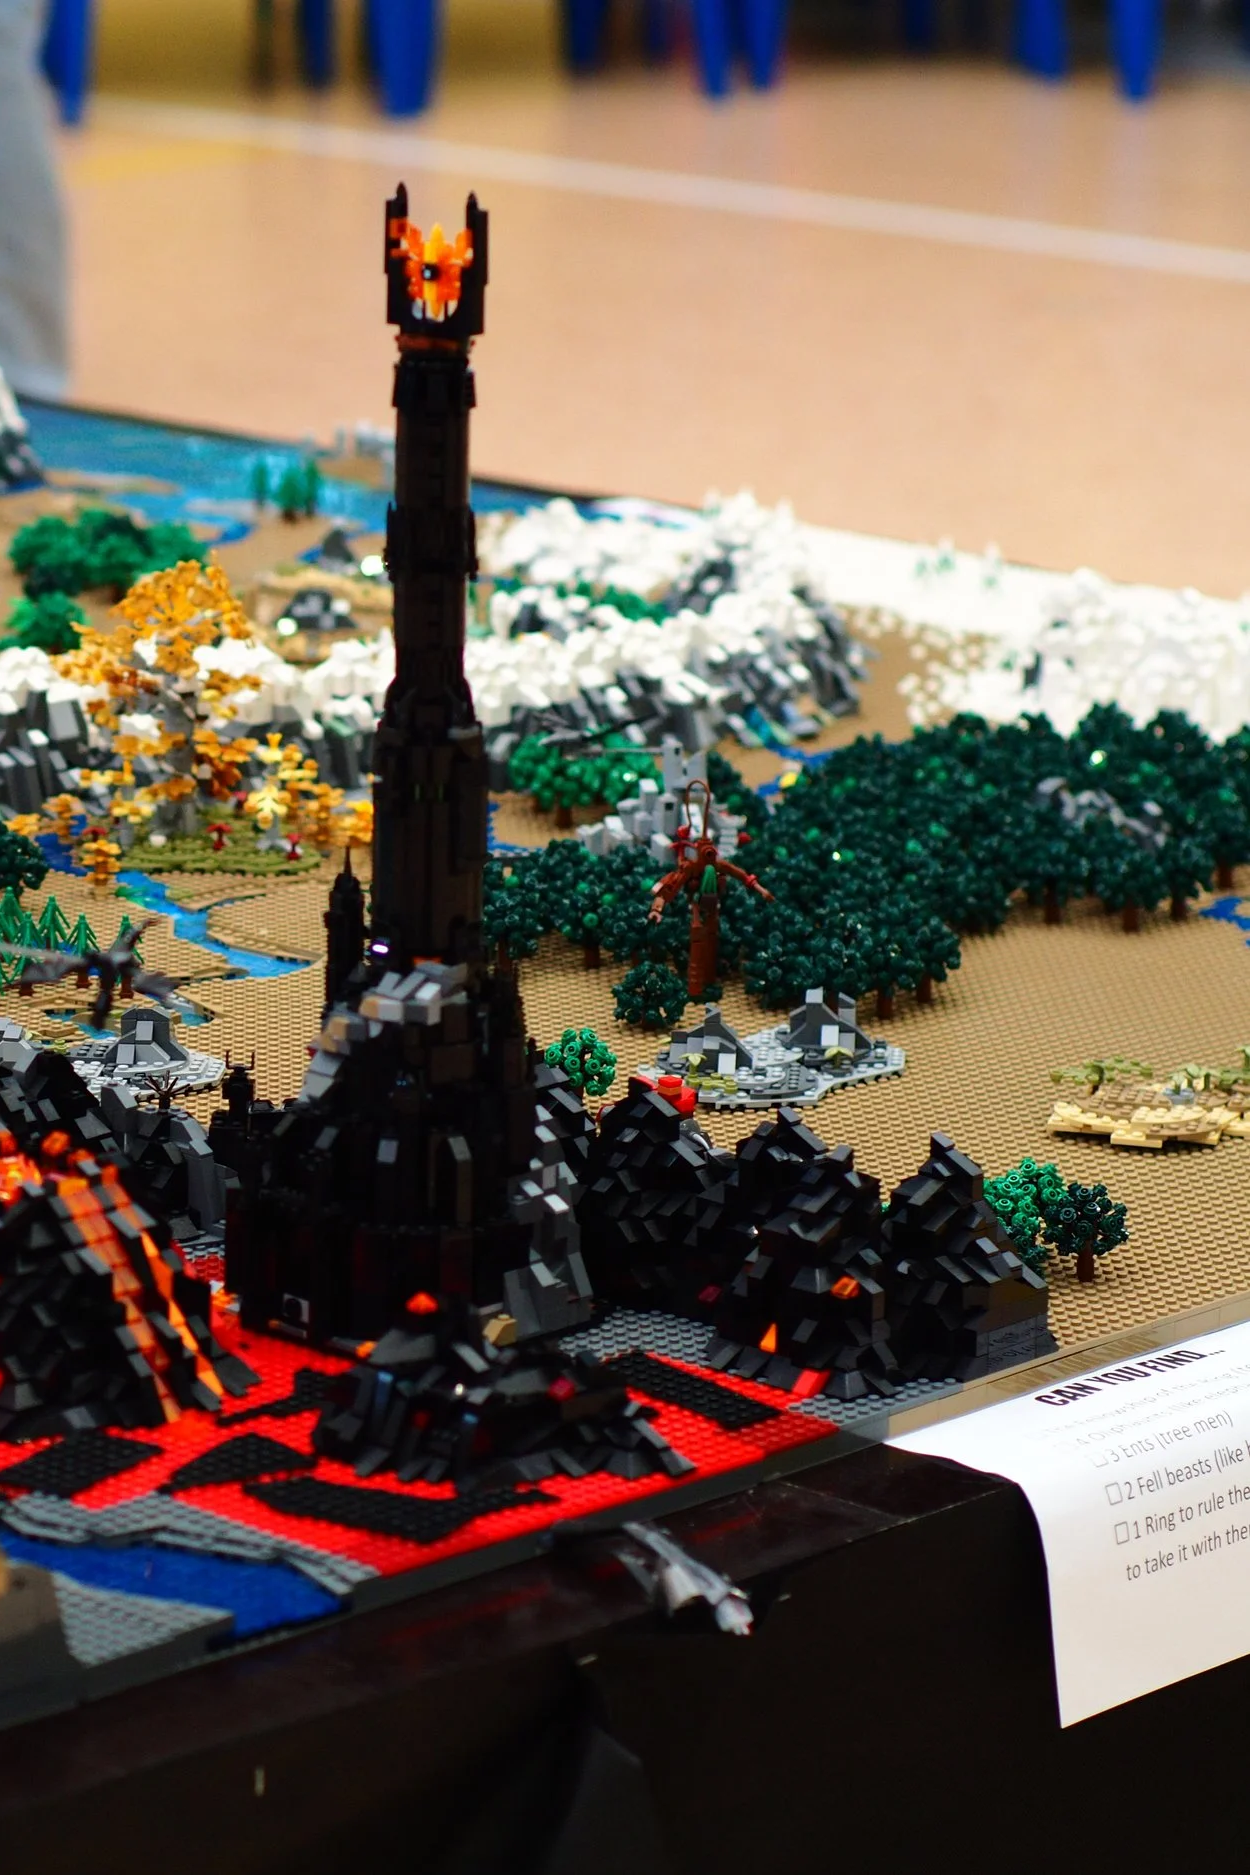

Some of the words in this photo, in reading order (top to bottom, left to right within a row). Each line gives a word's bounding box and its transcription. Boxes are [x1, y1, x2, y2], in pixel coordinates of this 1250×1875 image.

[1034, 1382, 1102, 1406] CAN
[1084, 1366, 1151, 1385] YOU
[1108, 1449, 1120, 1463] 3
[1118, 1440, 1155, 1458] Ents
[1154, 1425, 1193, 1449] (tree
[1194, 1410, 1234, 1433] men)
[1124, 1481, 1135, 1500] 2
[1137, 1470, 1164, 1496] Fell
[1165, 1458, 1212, 1485] beasts
[1214, 1446, 1244, 1473] (like
[1133, 1520, 1142, 1540] 1
[1145, 1513, 1176, 1534] Ring
[1179, 1505, 1194, 1523] to
[1197, 1492, 1225, 1517] rule
[1126, 1563, 1141, 1581] to
[1144, 1550, 1174, 1575] take
[1178, 1544, 1188, 1563] it
[1191, 1531, 1222, 1557] with
[1225, 1524, 1250, 1545] the
